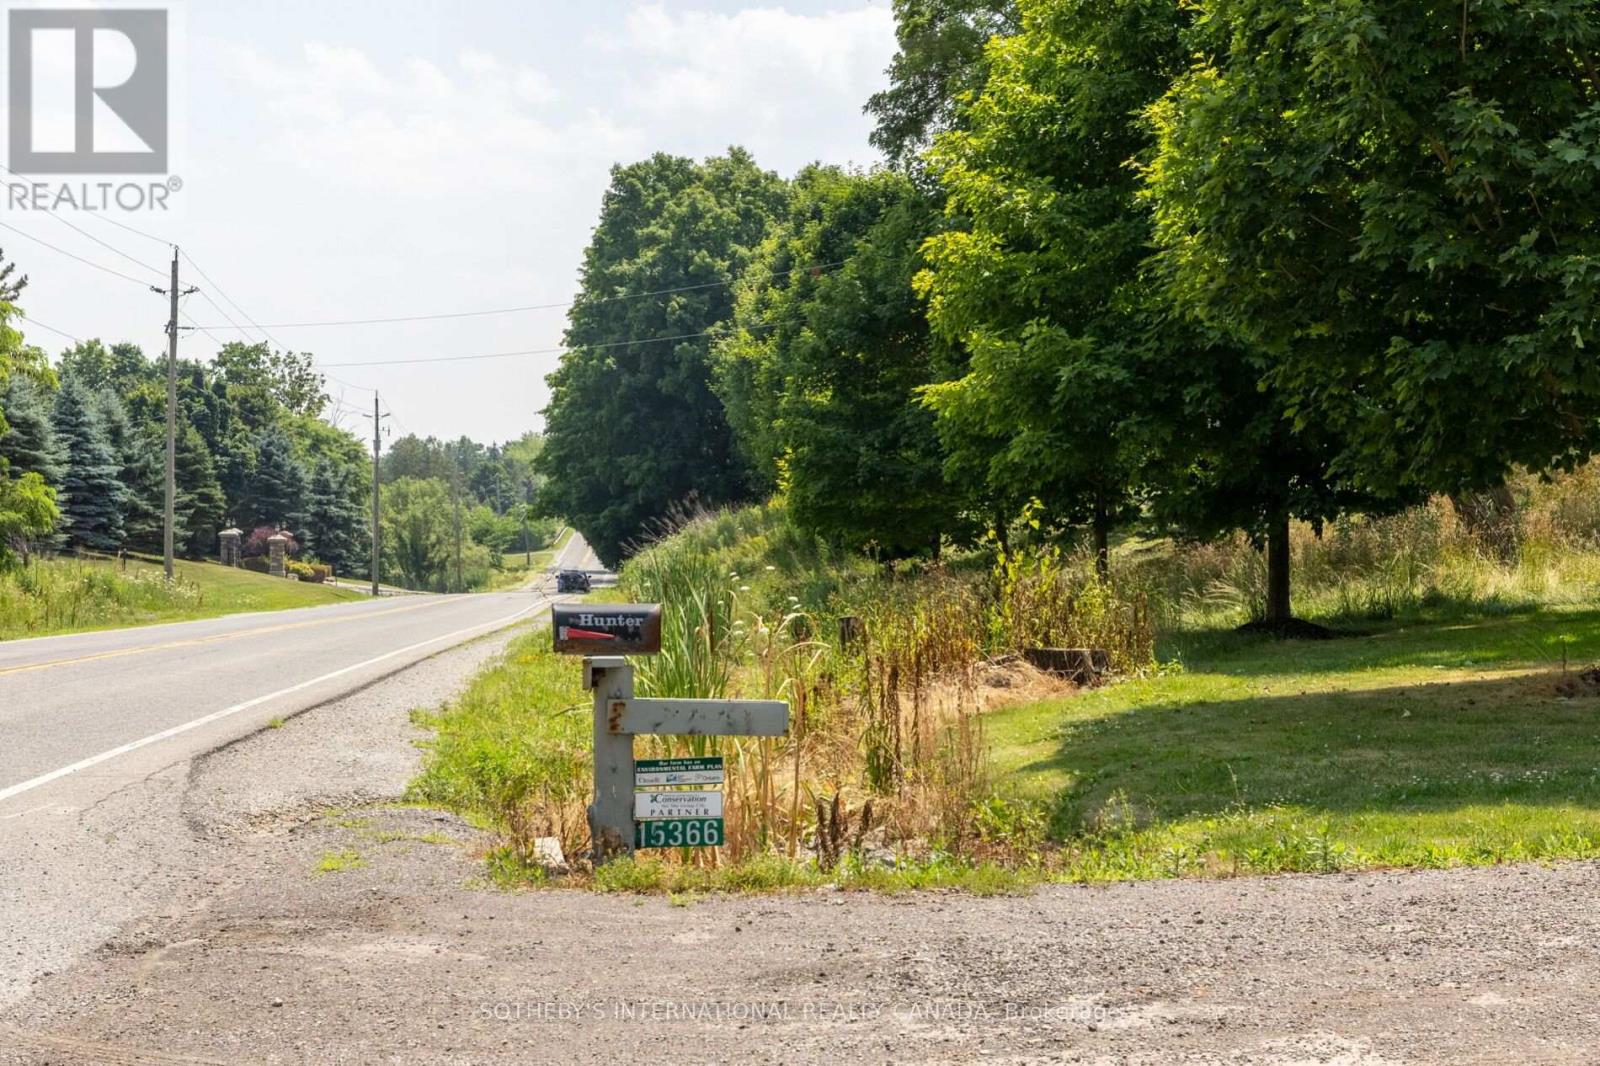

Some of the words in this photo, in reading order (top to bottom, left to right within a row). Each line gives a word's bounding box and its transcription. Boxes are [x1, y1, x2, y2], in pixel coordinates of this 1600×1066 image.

[579, 614, 643, 626] Hunter
[655, 793, 707, 803] Conservation
[650, 808, 710, 816] PARTNER
[639, 820, 718, 847] 15366
